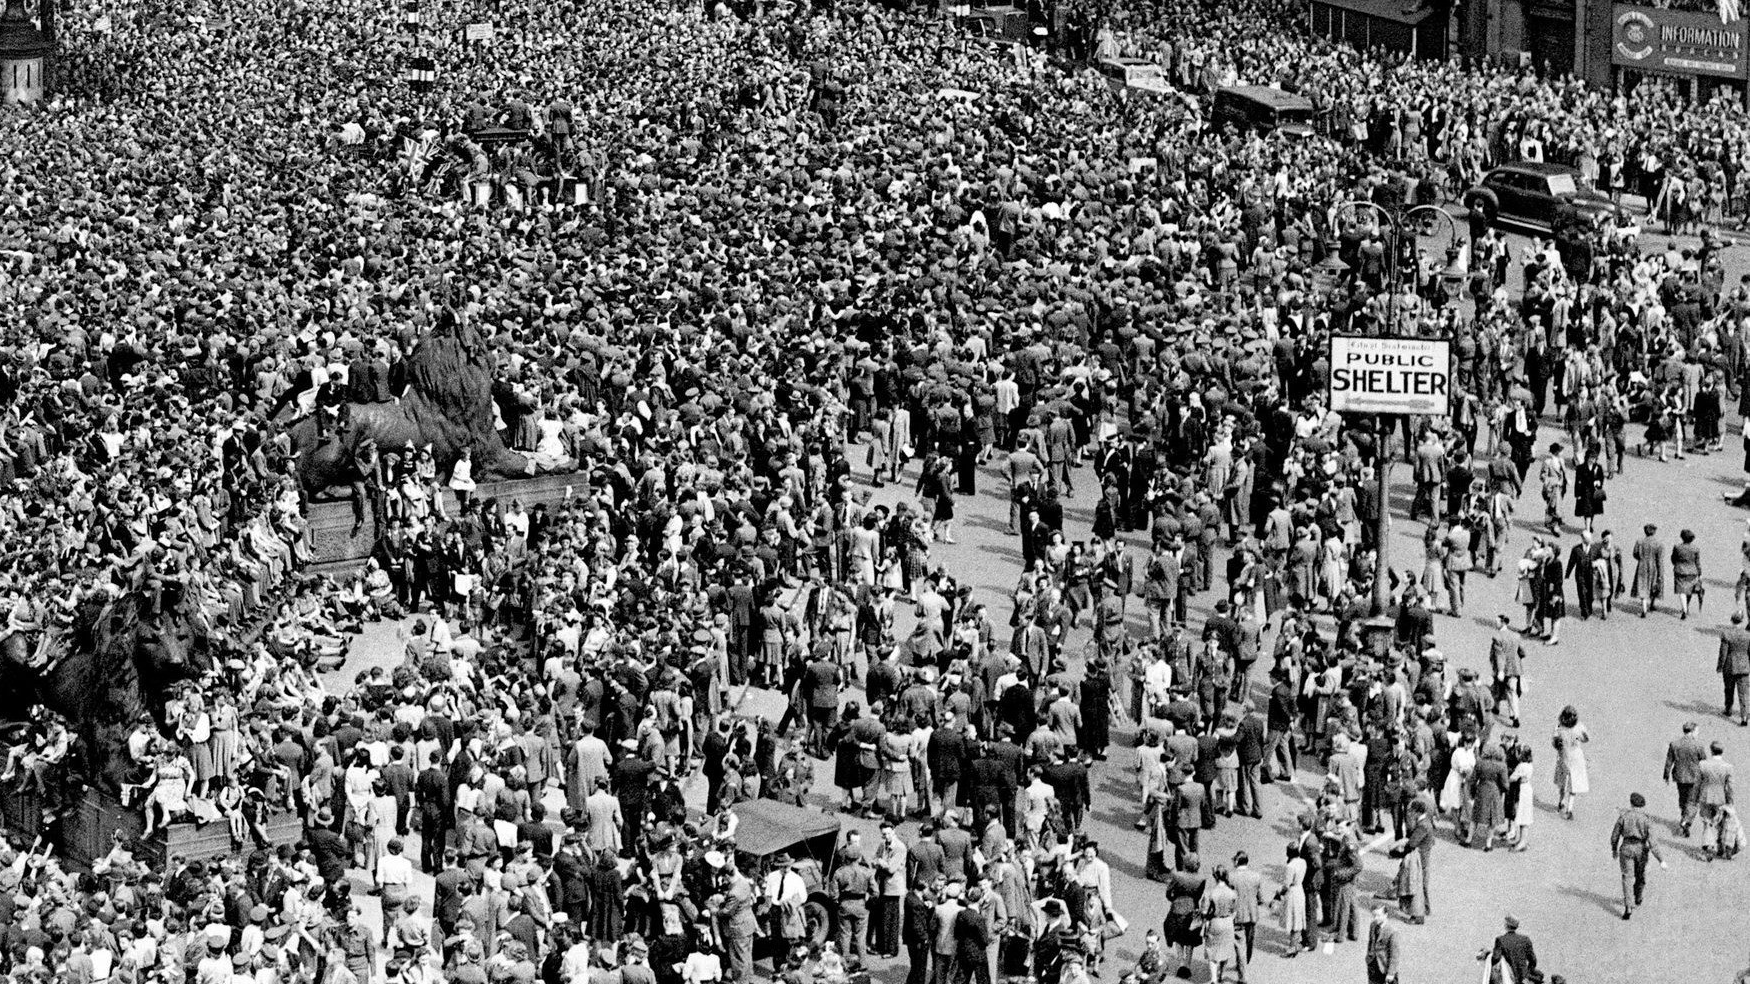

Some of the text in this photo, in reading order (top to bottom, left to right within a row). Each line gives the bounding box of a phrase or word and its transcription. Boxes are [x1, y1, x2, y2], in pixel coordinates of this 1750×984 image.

[1661, 24, 1740, 49] INFORMATION
[1346, 352, 1434, 367] PUBLIC
[1332, 368, 1447, 396] SHELTER
